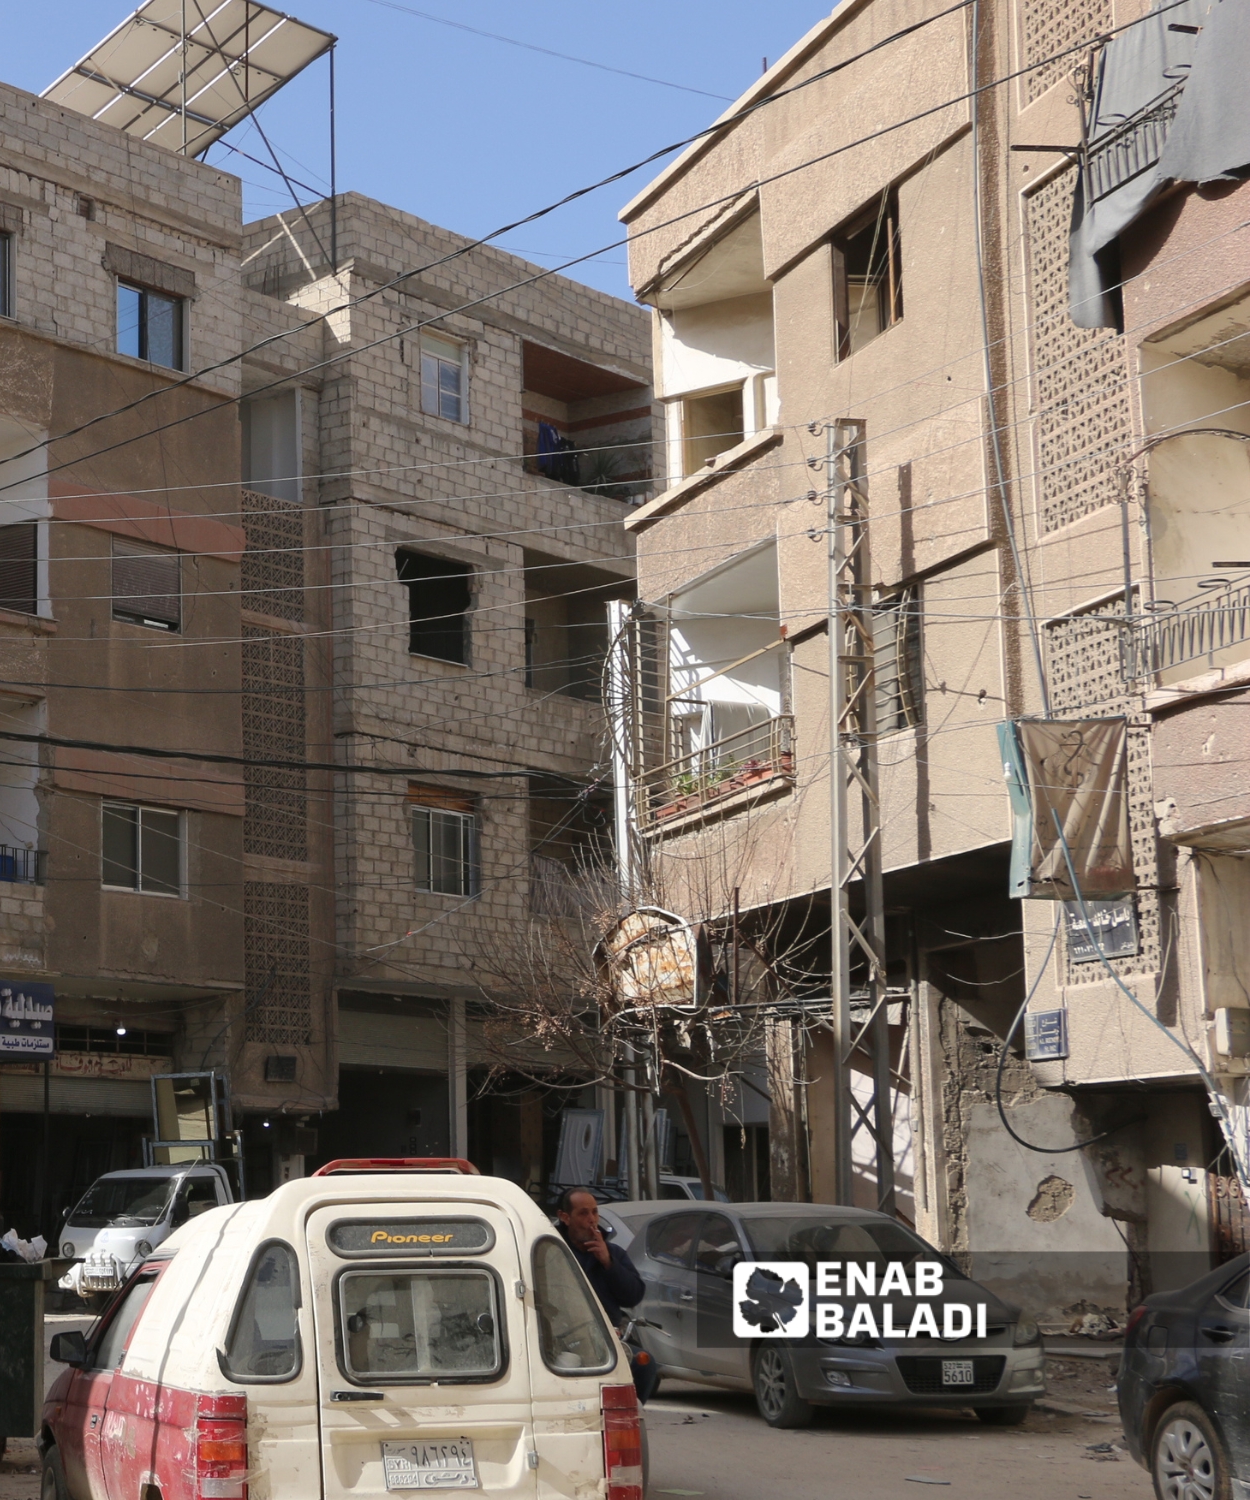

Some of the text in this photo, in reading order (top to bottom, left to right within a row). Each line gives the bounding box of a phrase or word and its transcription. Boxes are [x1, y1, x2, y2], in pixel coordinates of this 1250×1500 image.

[0, 988, 53, 1029] صيدلية
[2, 1036, 50, 1050] مستلزمات طبية
[371, 1231, 454, 1243] Pioneer
[944, 1370, 972, 1383] 5610
[424, 1472, 470, 1486] دمشق
